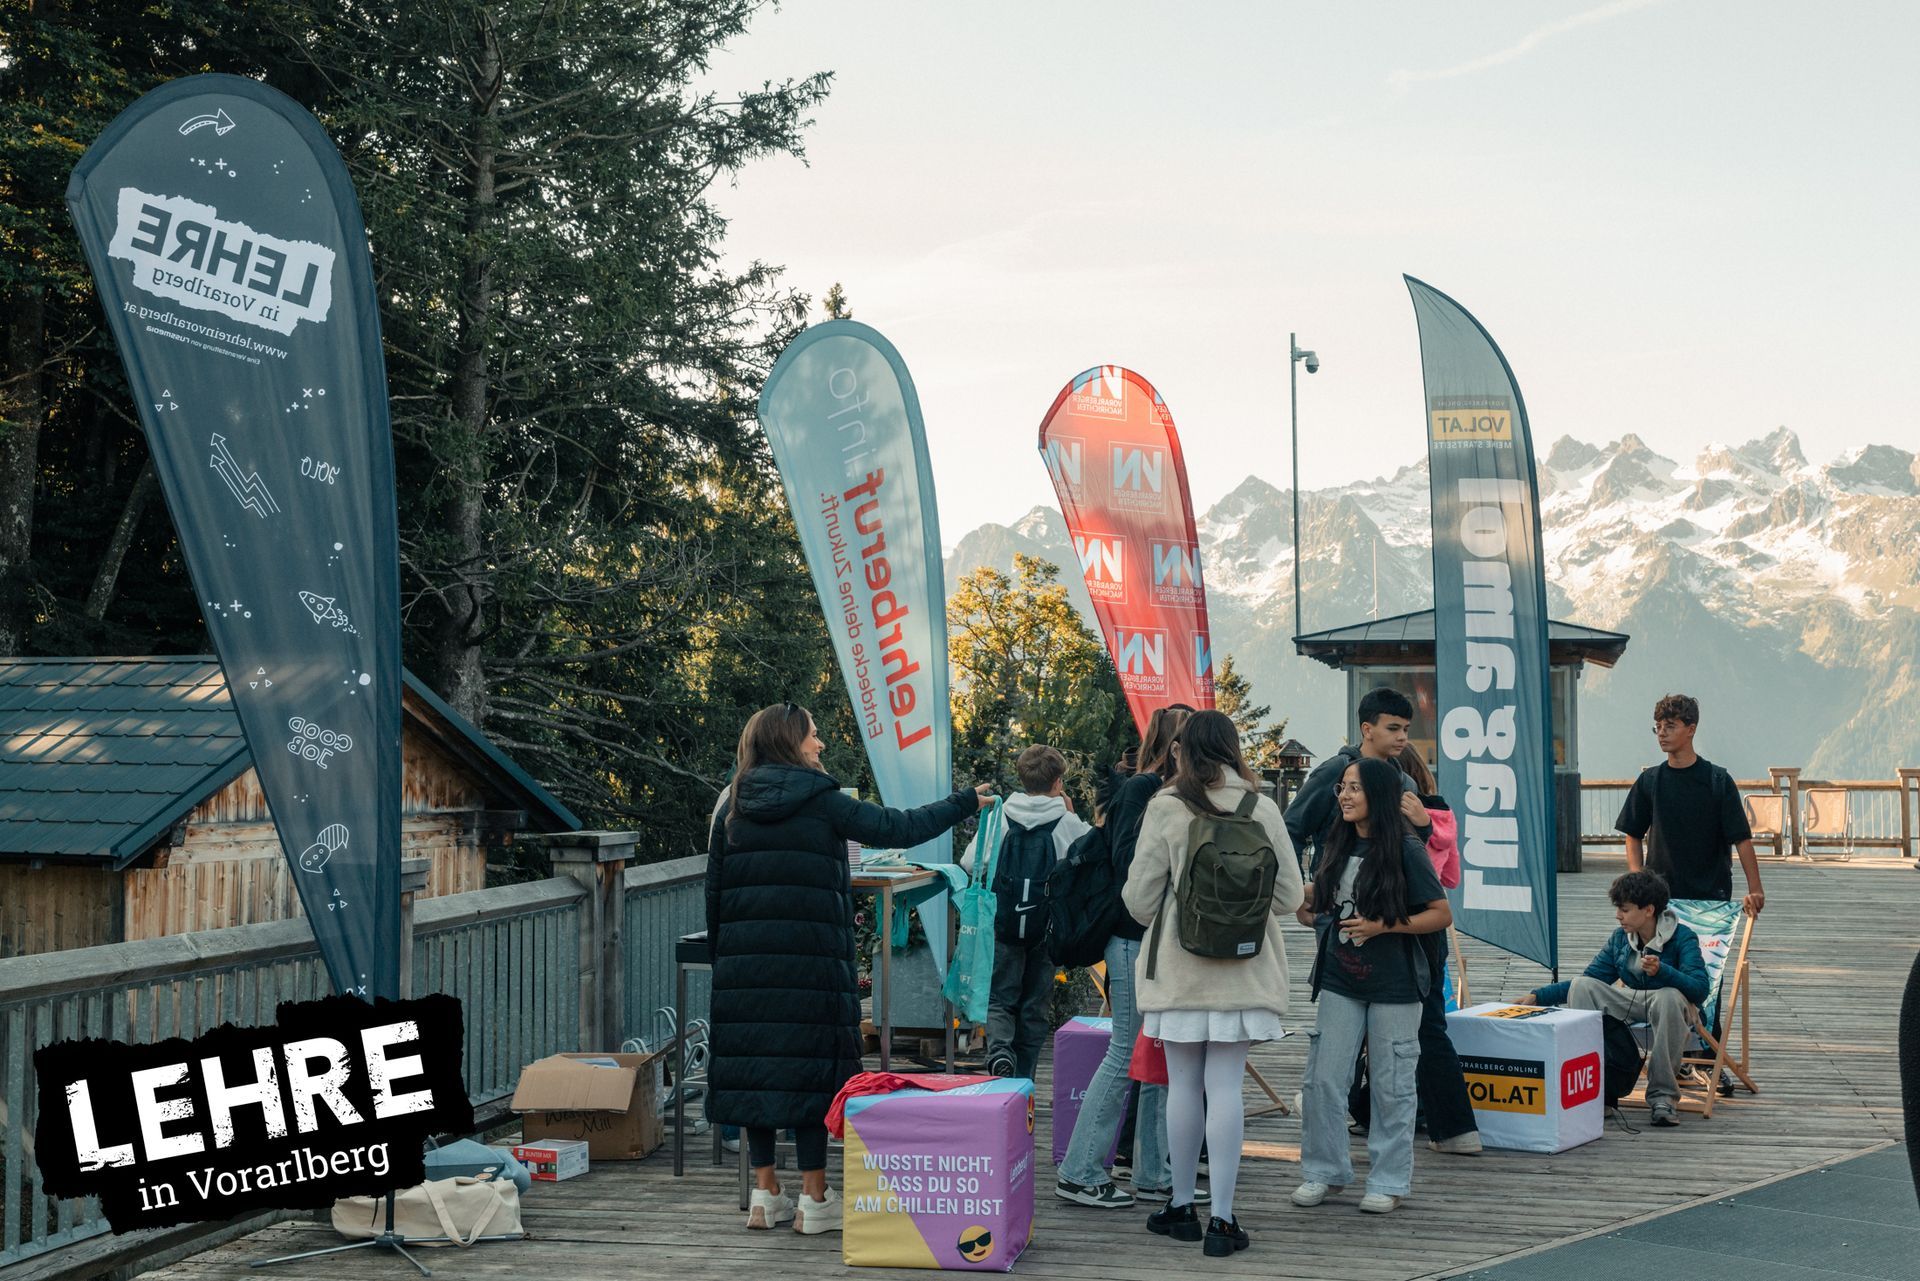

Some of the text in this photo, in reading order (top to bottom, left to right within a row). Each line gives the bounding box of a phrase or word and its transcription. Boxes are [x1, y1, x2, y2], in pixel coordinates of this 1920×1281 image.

[1459, 1061, 1538, 1074] ORARLBERG ONLINE
[1567, 1065, 1594, 1096] LIVE
[863, 1154, 994, 1176] WUSSTE NICHT,
[877, 1175, 979, 1194] DASS DU SO
[854, 1196, 1003, 1216] AM CHILLEN BIST
